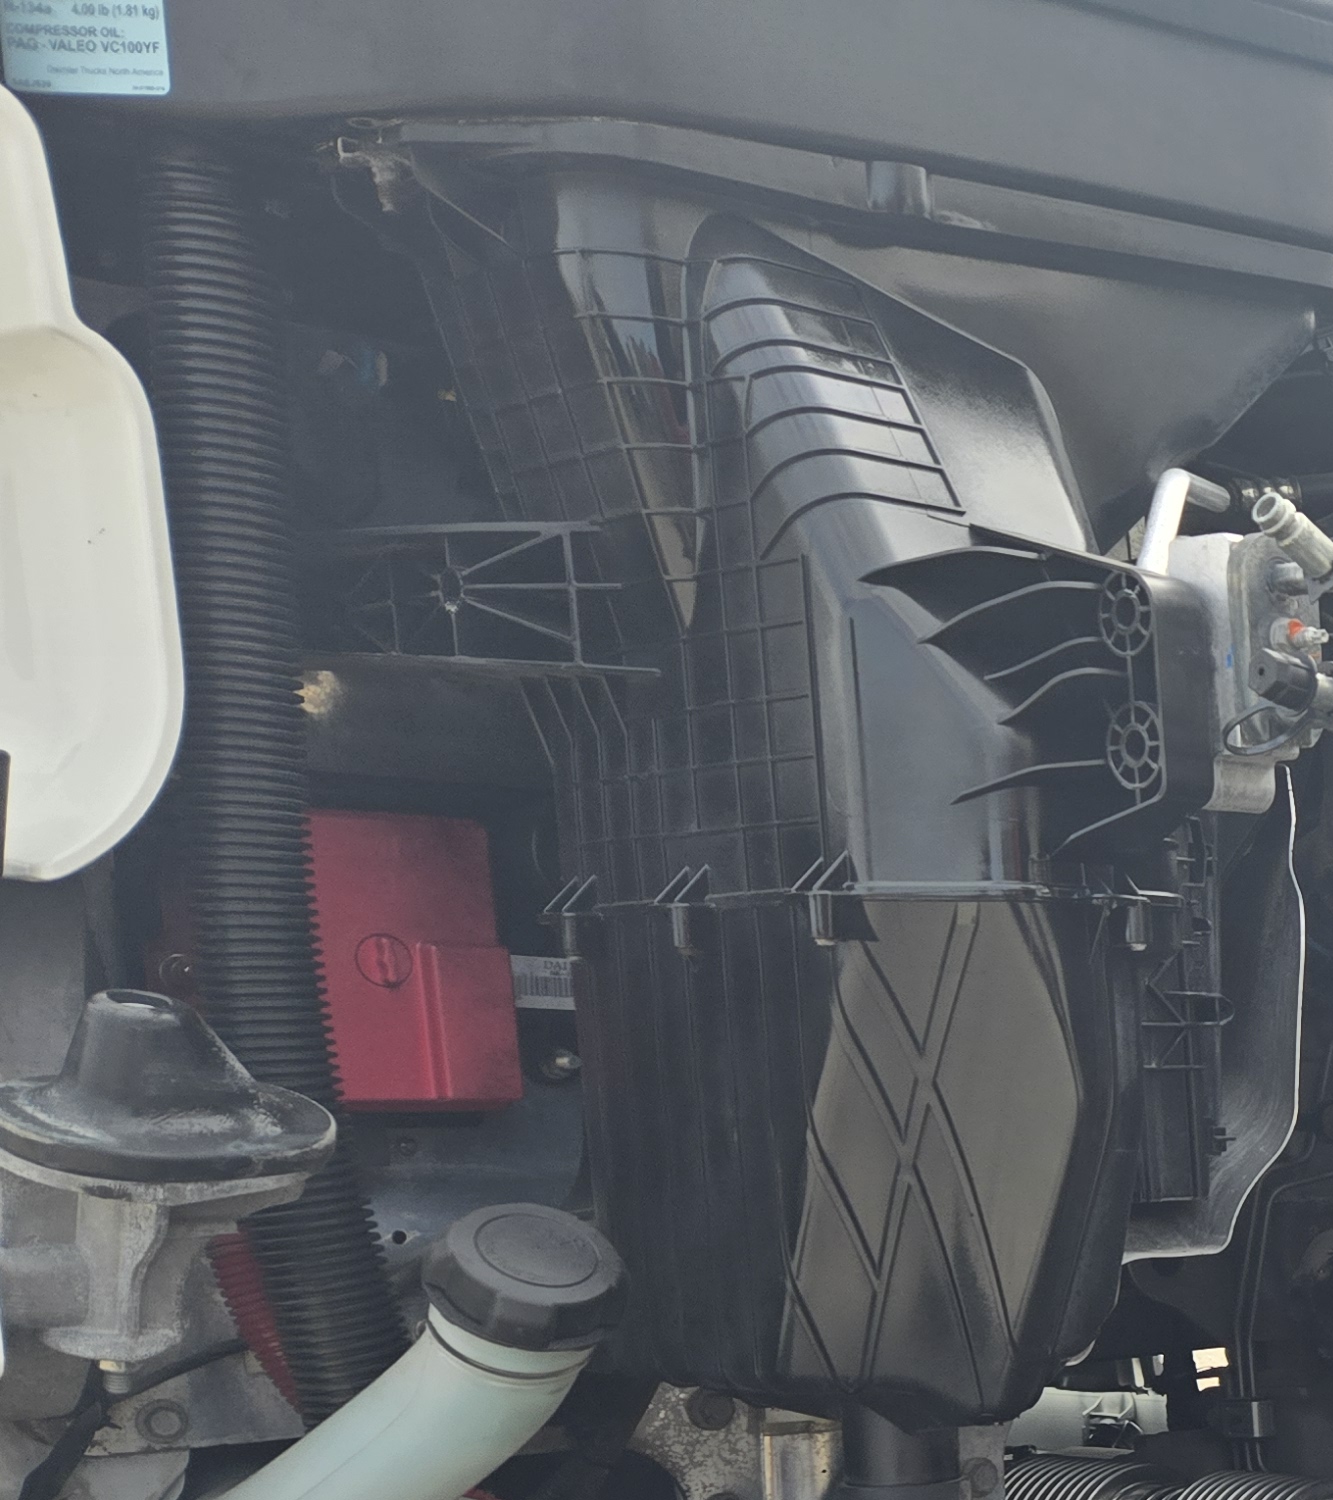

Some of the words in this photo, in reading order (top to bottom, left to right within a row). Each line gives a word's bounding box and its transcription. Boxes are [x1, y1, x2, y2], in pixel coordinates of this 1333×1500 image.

[98, 4, 109, 16] lb
[142, 5, 160, 20] kg)
[5, 23, 97, 37] COMPRESSOR
[100, 26, 125, 38] OIL:
[48, 39, 96, 53] VALEO
[100, 40, 160, 54] VC100YF
[81, 65, 107, 75] Trucks
[109, 66, 130, 75] North
[132, 66, 164, 76] America
